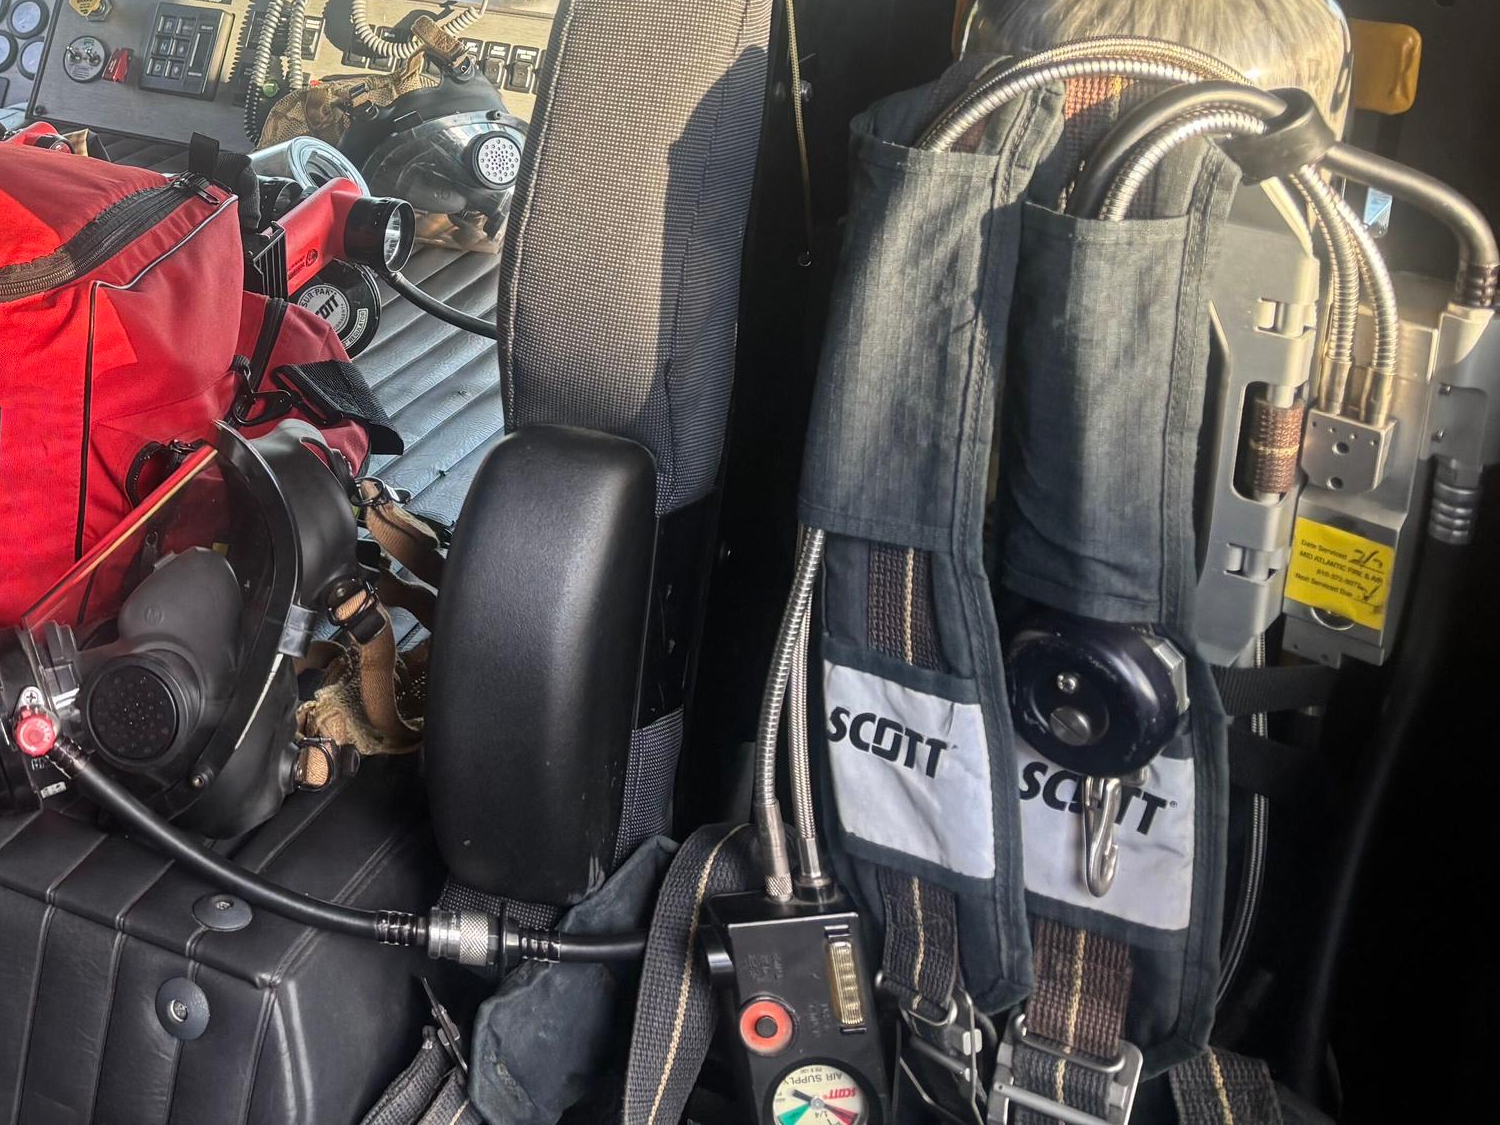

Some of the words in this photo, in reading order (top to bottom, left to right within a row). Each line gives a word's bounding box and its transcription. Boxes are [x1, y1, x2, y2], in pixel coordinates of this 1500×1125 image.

[826, 706, 948, 780] SCOTT
[782, 1074, 823, 1086] SUPPLY
[825, 1072, 843, 1081] AIR
[828, 1087, 857, 1100] SCOTT
